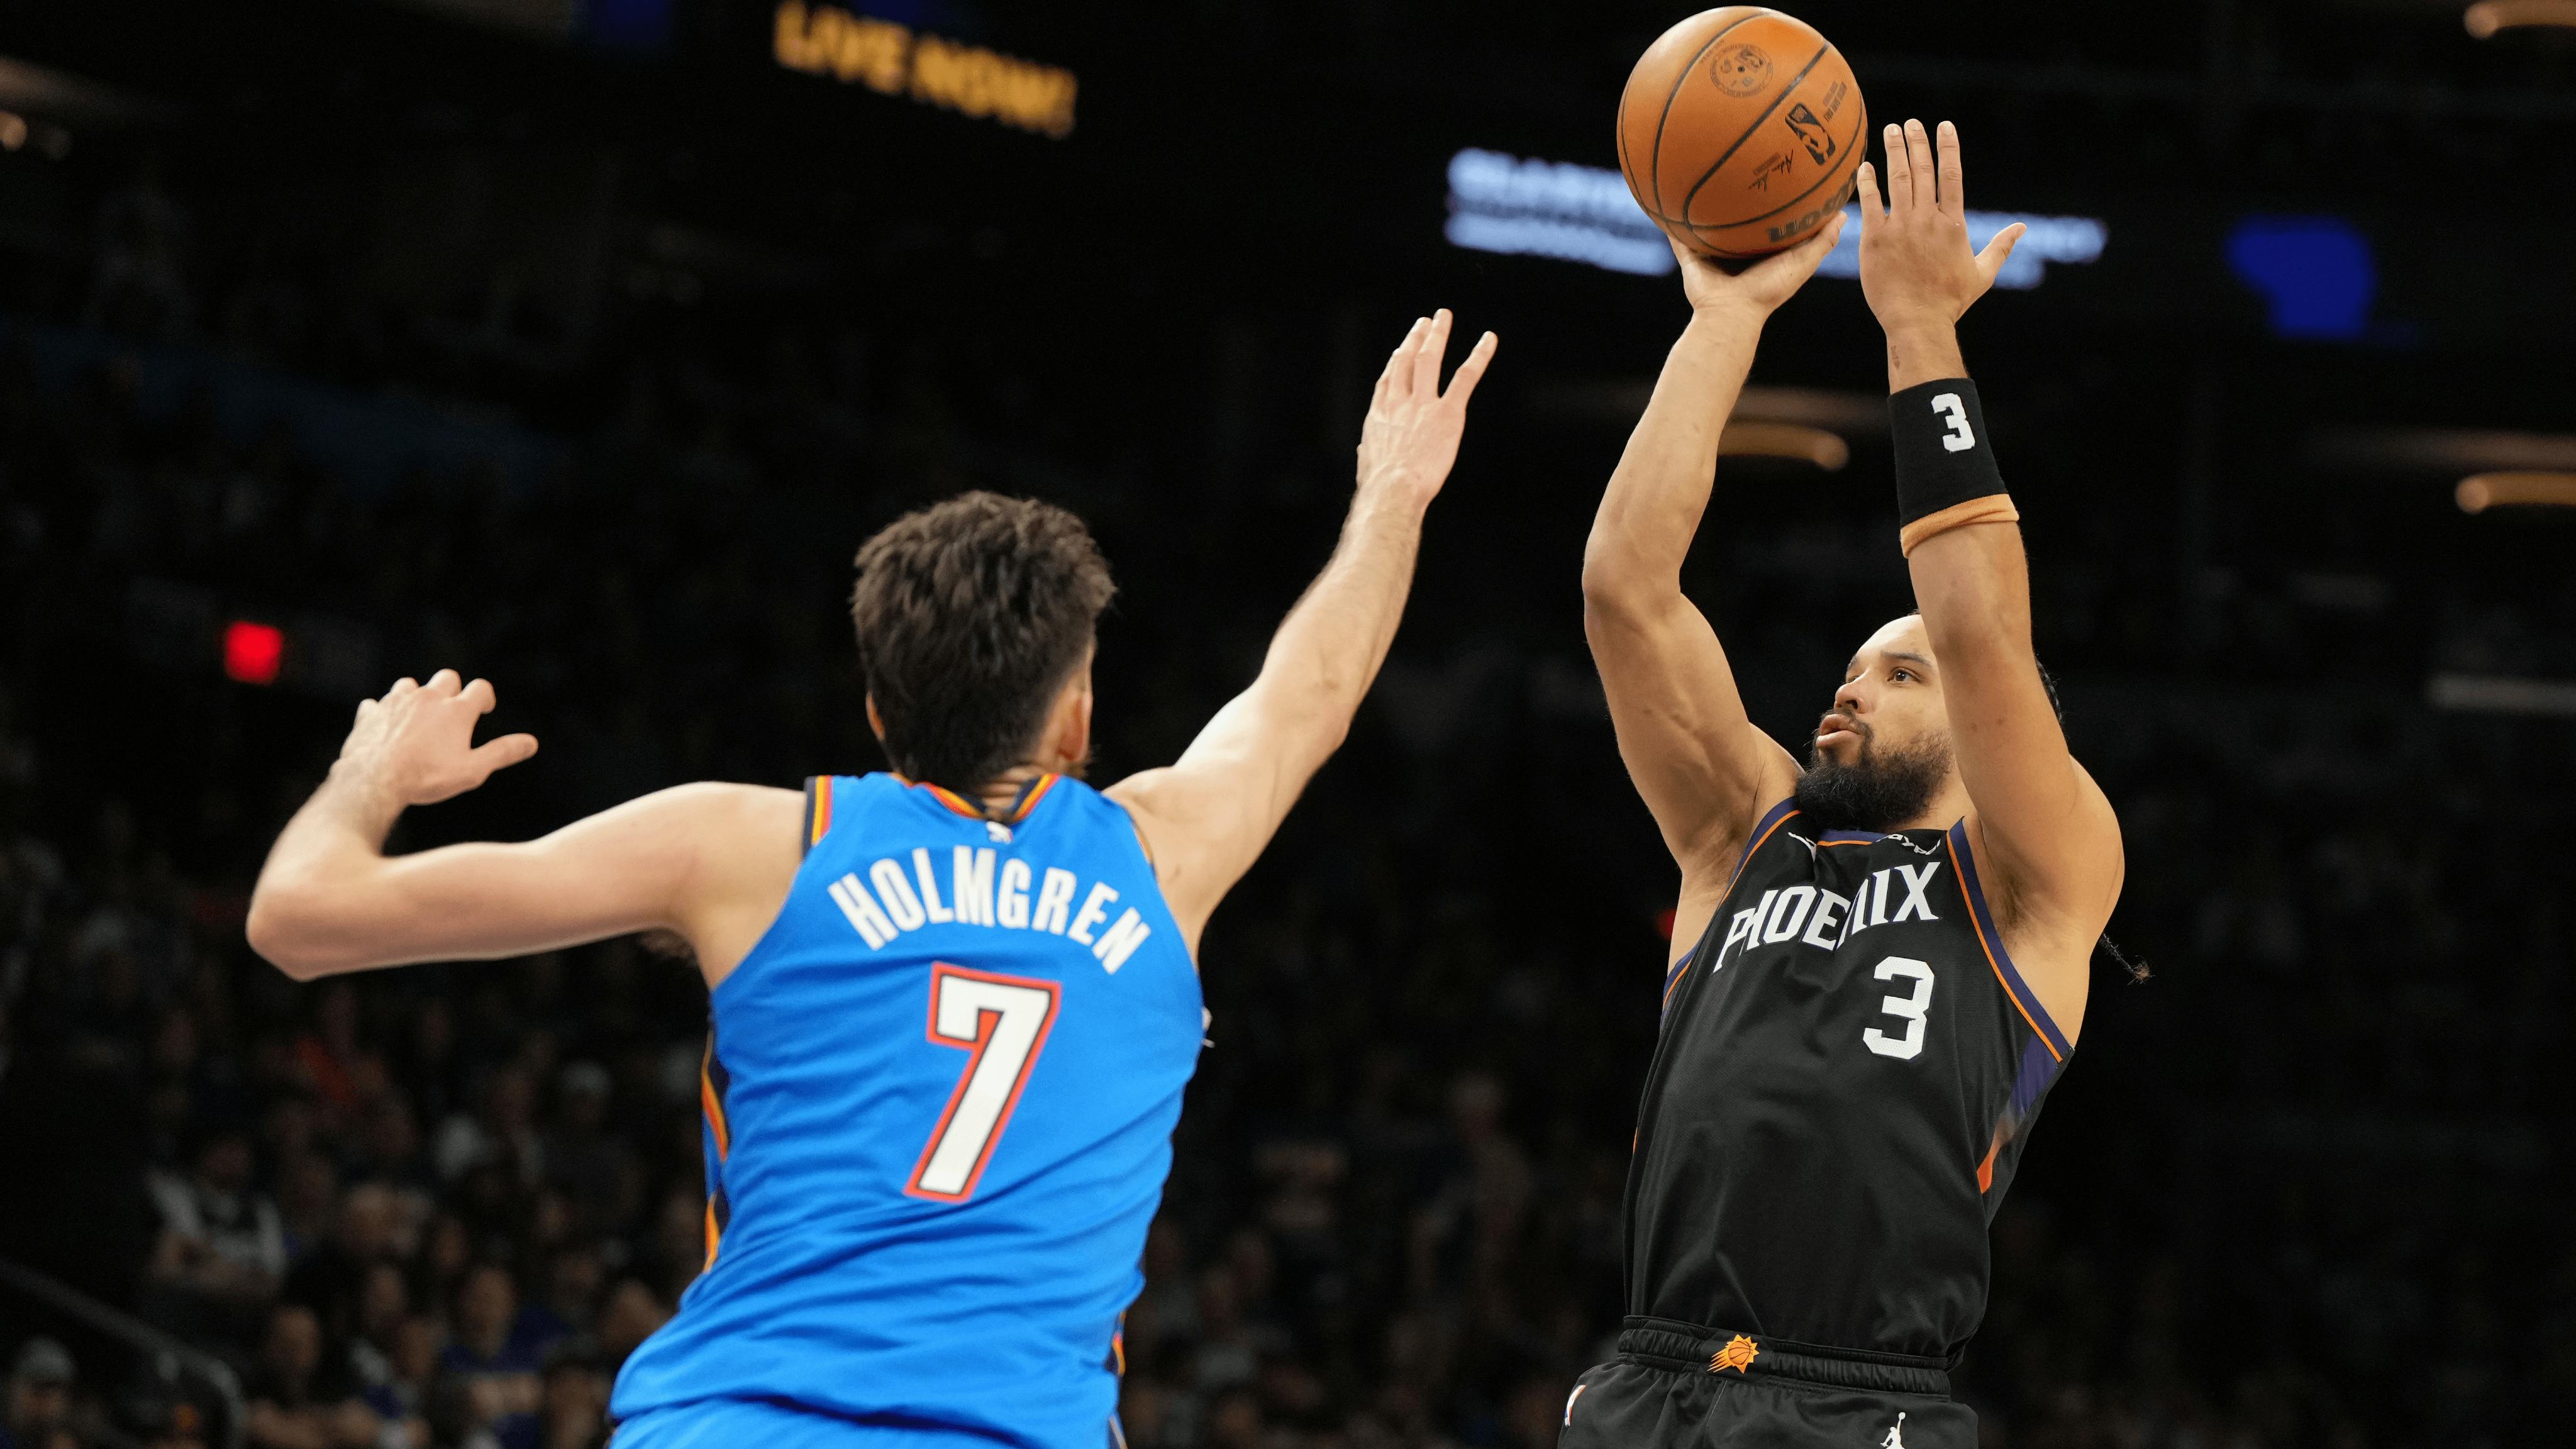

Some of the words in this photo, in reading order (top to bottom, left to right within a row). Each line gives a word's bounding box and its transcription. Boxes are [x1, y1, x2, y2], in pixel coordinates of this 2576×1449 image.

[776, 1, 911, 92] LIVE
[1931, 392, 1975, 453] 3
[827, 845, 1152, 975] HOLMGREN
[1711, 861, 1941, 975] PHOENIX
[1862, 955, 1935, 1060] 3
[903, 961, 1062, 1205] 7
